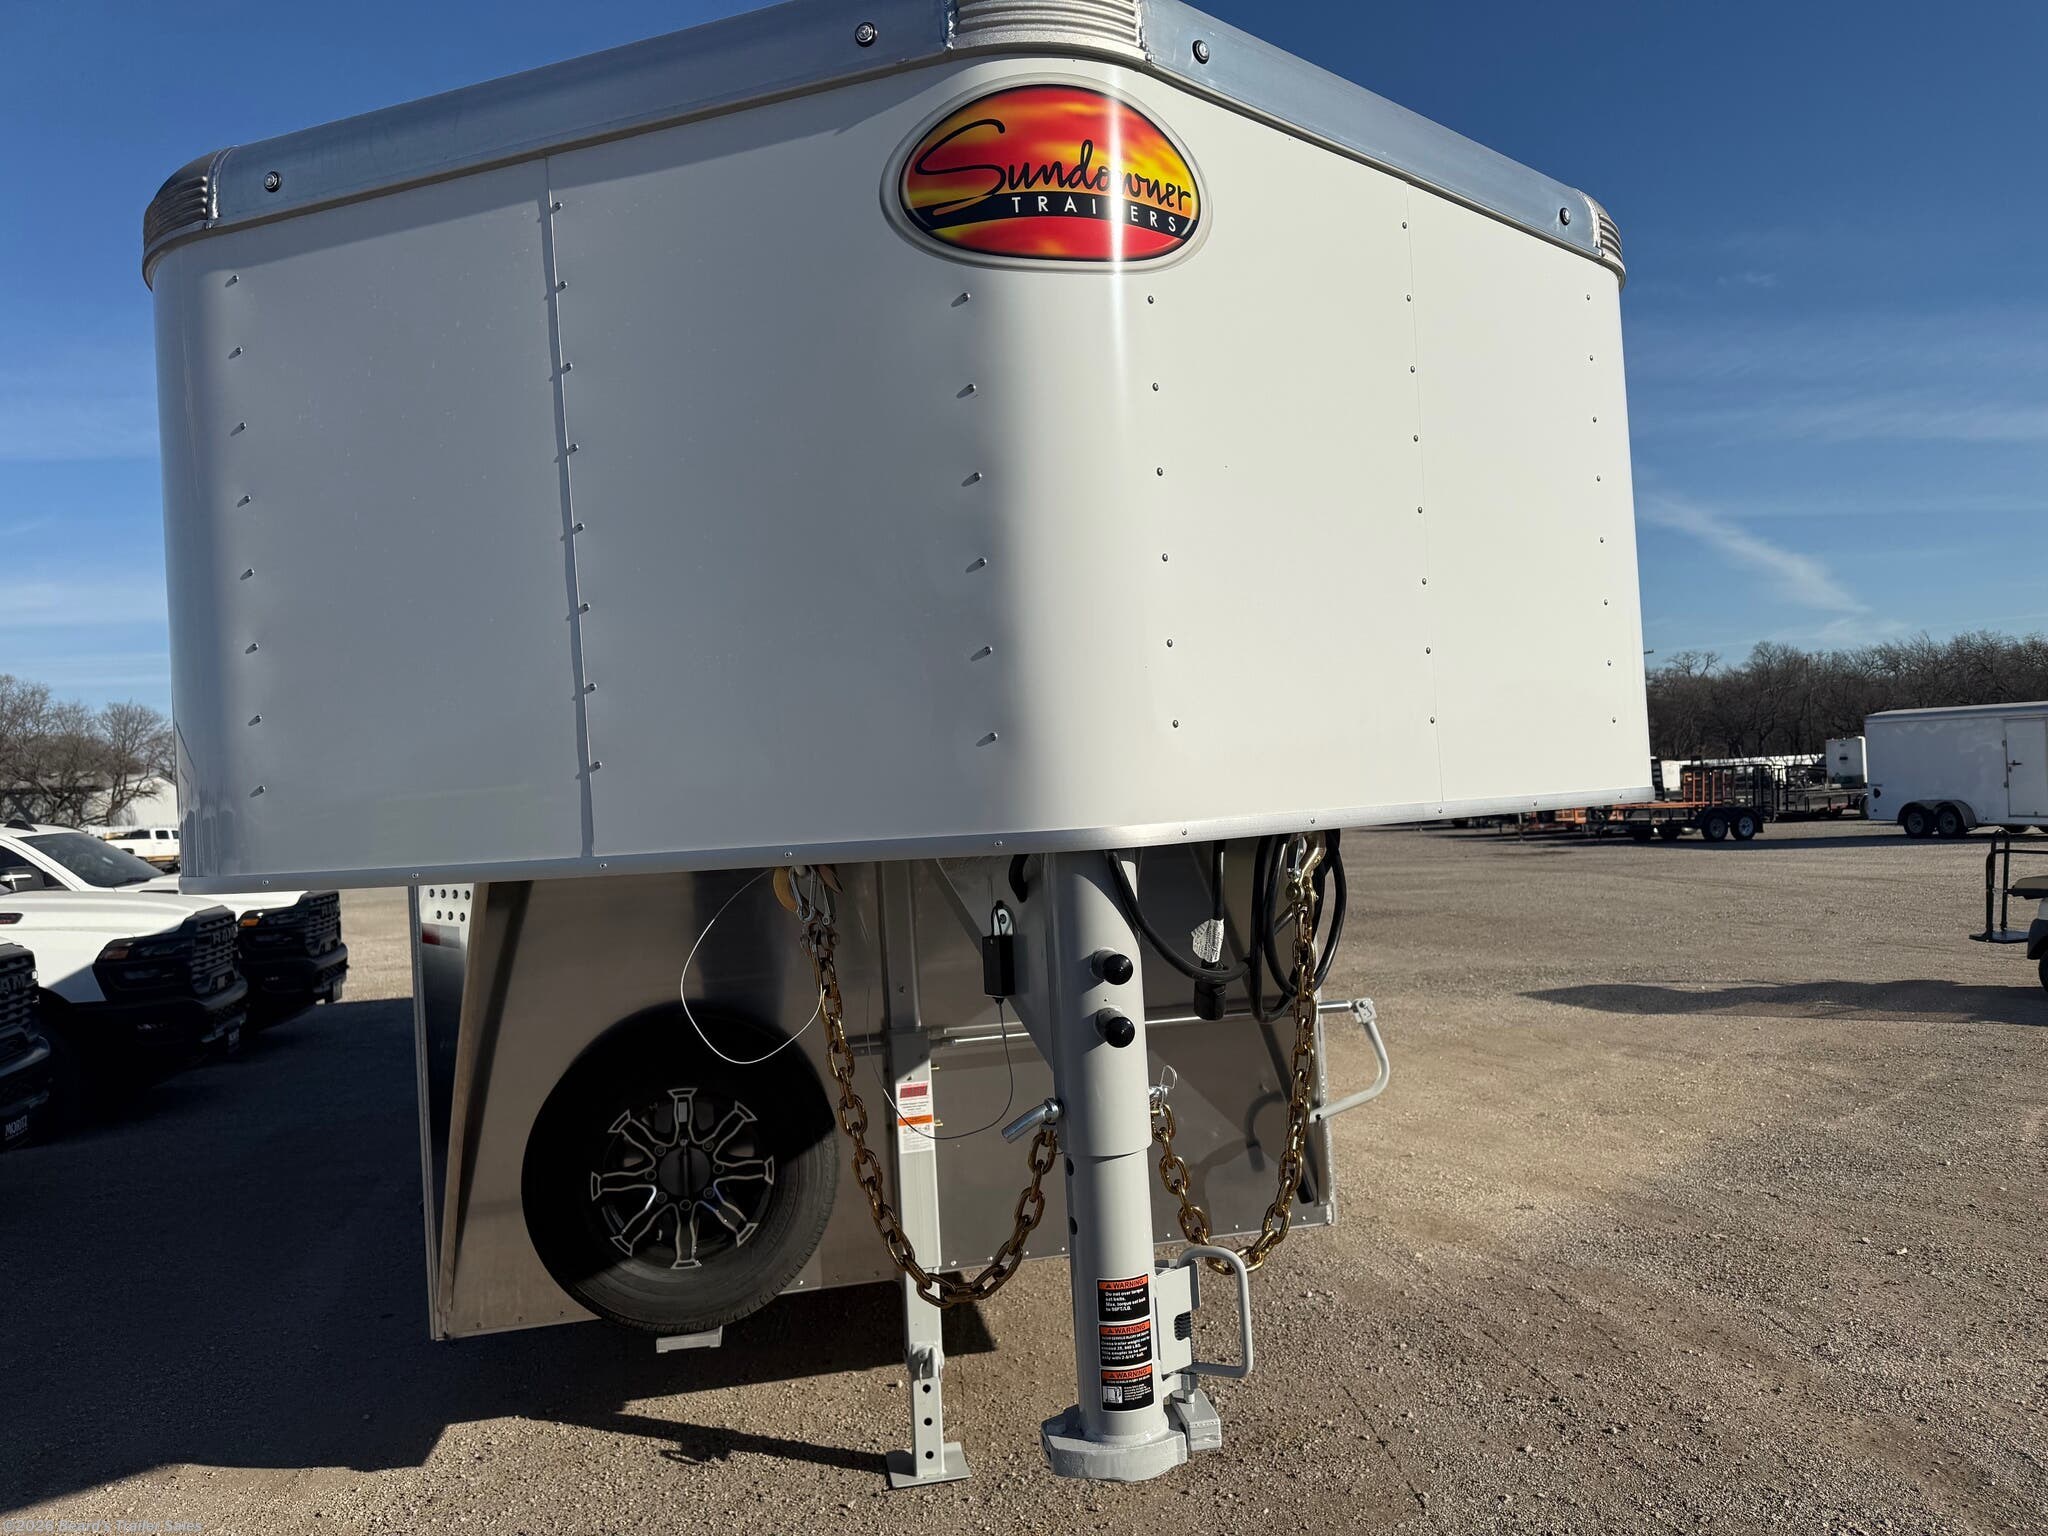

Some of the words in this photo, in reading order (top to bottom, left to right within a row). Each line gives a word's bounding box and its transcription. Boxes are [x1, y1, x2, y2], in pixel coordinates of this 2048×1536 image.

[1011, 195, 1177, 233] TRAIERS
[212, 925, 239, 946] RAM
[0, 973, 25, 993] AM
[1113, 1279, 1144, 1289] WARNING
[1115, 1324, 1146, 1334] WARNING
[1117, 1369, 1148, 1378] WARNING
